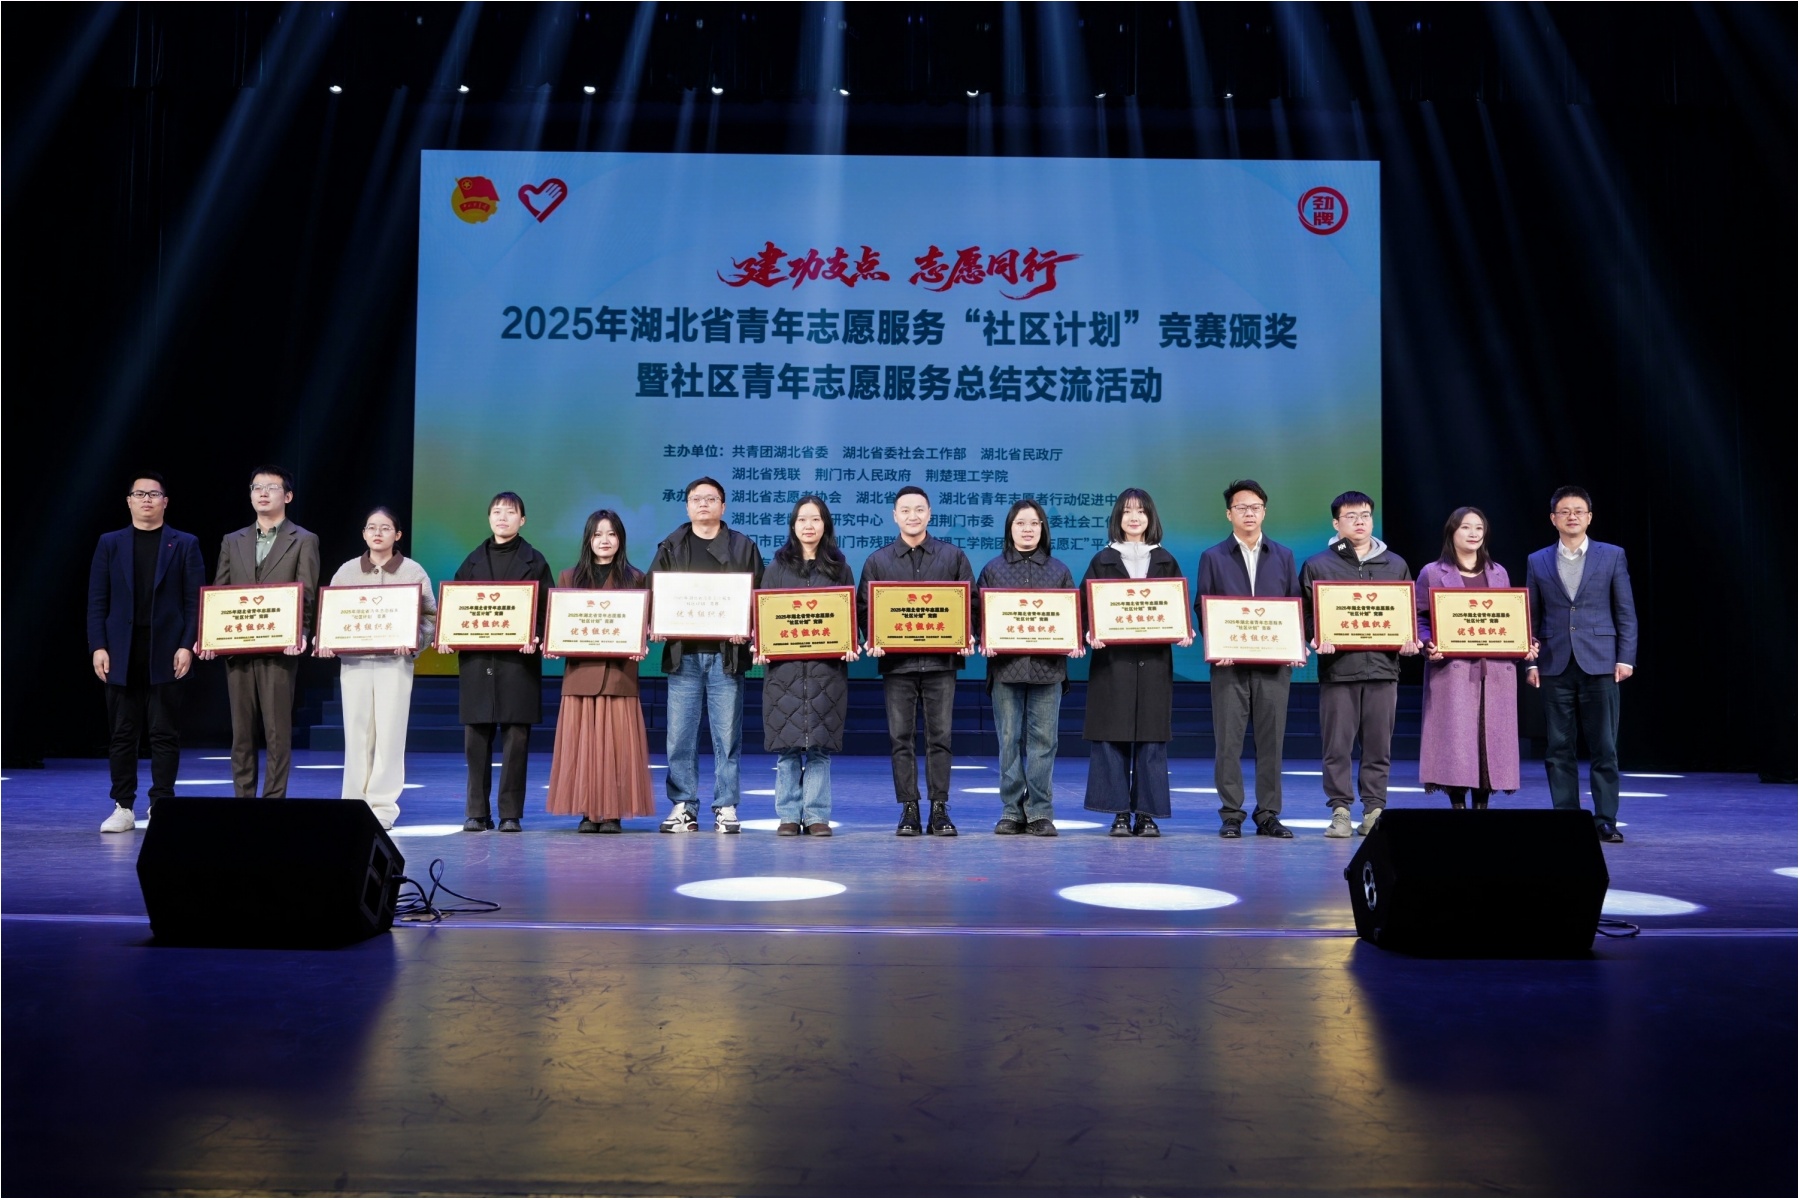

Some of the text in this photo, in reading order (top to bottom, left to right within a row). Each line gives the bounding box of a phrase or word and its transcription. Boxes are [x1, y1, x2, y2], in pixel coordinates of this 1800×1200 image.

[1312, 196, 1335, 210] 劲
[1313, 211, 1335, 226] 牌
[717, 241, 1085, 300] 建功支点 志愿同行
[635, 362, 1163, 403] 暨社区青年志愿服务总结交流活动
[732, 445, 829, 459] 共青团湖北省委
[843, 446, 967, 460] 湖北省委社会工作部
[981, 448, 1063, 461] 湖北省民政厅
[732, 467, 1009, 483] 湖北省残联 荆门市人民政府 荆楚理工学院
[933, 536, 1005, 549] 理工学院团
[461, 619, 510, 628] 优秀组织奖
[1115, 614, 1165, 623] 优秀组织奖
[224, 622, 275, 633] 优秀组织奖
[343, 623, 393, 632] 优秀组织奖
[894, 622, 945, 631] 优秀组织奖
[1007, 625, 1056, 633] 优秀组织奖
[1341, 619, 1391, 629] 优秀组织奖
[571, 627, 620, 636] 优秀组织奖
[780, 628, 831, 638] 优秀组织奖
[1458, 627, 1507, 636] 优秀组织奖
[1230, 634, 1279, 642] 优秀组织奖
